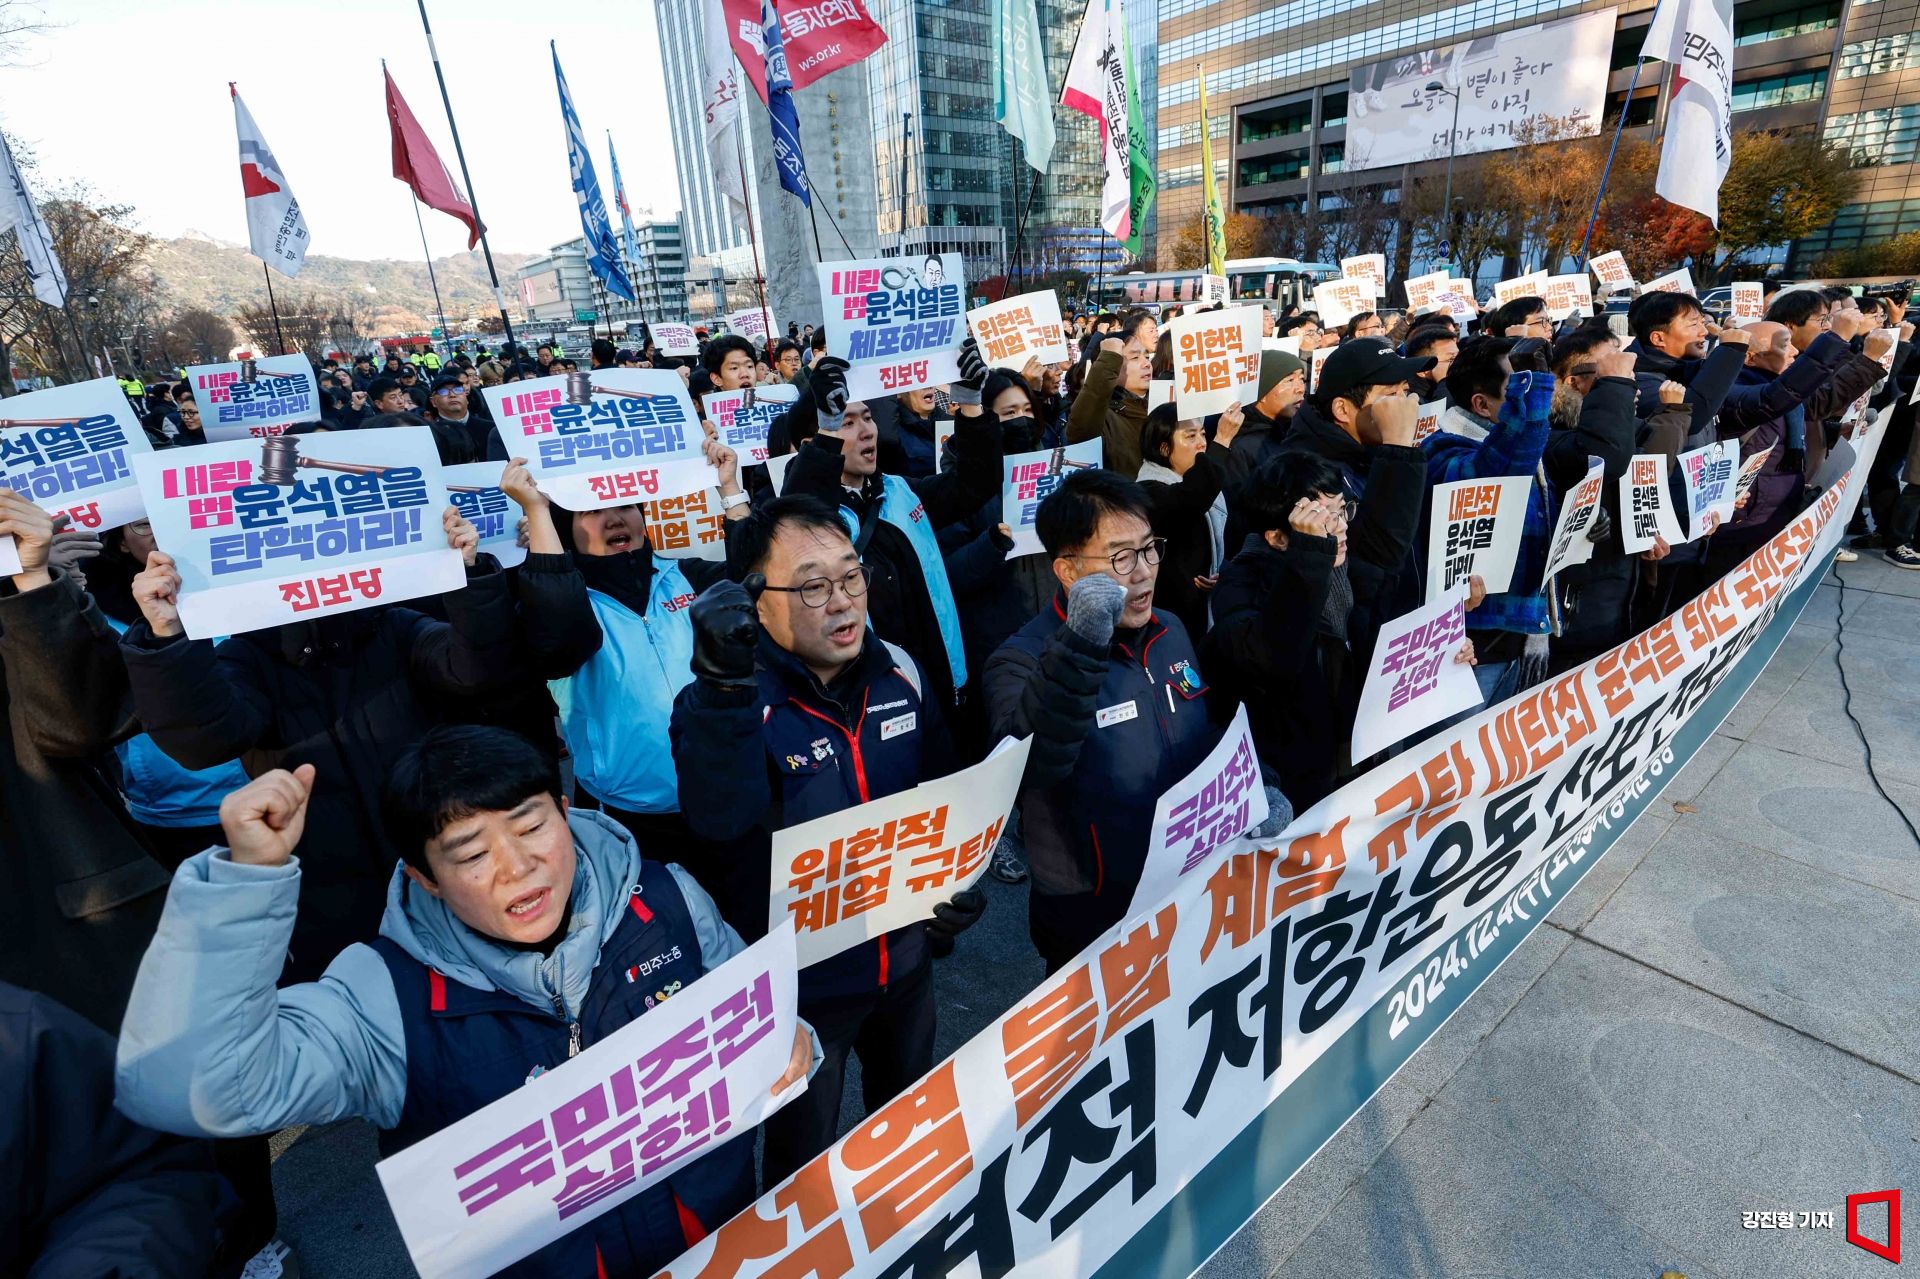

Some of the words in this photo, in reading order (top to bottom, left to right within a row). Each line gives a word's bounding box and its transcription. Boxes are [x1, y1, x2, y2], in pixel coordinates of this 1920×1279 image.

[798, 42, 842, 72] ws.or.kr
[1512, 56, 1553, 86] 좋다
[1491, 88, 1530, 115] 아직
[1481, 118, 1514, 137] 여기
[832, 269, 880, 296] 내란
[1735, 289, 1760, 303] 위헌적
[733, 311, 771, 329] 국민주권
[844, 293, 867, 320] 범
[866, 284, 960, 326] 윤석열을
[1735, 303, 1752, 318] 계엄
[655, 327, 694, 338] 국민주권
[977, 306, 1034, 339] 위헌적
[667, 337, 690, 348] 실현!
[848, 318, 955, 361] 체포하라!
[984, 335, 1026, 362] 계엄
[1027, 323, 1062, 349] 규탄!
[1179, 324, 1243, 363] 위헌적
[198, 371, 239, 390] 내란
[210, 388, 231, 404] 범
[229, 373, 311, 403] 윤석열을
[880, 360, 929, 390] 진보당
[1182, 358, 1231, 394] 계엄
[1234, 352, 1260, 386] 규탄!
[219, 394, 310, 423] 탄핵하라!
[501, 389, 562, 417] 내란
[520, 413, 553, 436] 범
[549, 394, 687, 436] 윤석열을
[711, 398, 741, 415] 내란
[0, 413, 129, 473] 석열을
[538, 424, 686, 469] 탄핵하라!
[163, 460, 252, 499] 내란
[1011, 461, 1047, 484] 내란
[1631, 460, 1657, 485] 내란죄
[1686, 454, 1703, 474] 내란
[189, 496, 234, 530] 범
[232, 466, 429, 530] 윤석열을
[588, 469, 660, 501] 진보당
[1017, 481, 1037, 501] 범
[1632, 485, 1661, 513] 윤석열
[450, 486, 510, 518] 열을
[1448, 484, 1502, 521] 내란죄
[210, 508, 423, 576] 탄핵하라!
[1445, 517, 1496, 557] 윤석열
[279, 568, 382, 613] 진보당
[1381, 597, 1465, 677] 국민주권
[1387, 650, 1447, 714] 실현!
[1164, 732, 1257, 849] 국민주권
[788, 805, 950, 894] 위헌적
[787, 866, 893, 934] 계엄
[905, 814, 1005, 894] 규탄!
[650, 1058, 975, 1279] 석열
[1001, 904, 1178, 1131] 불법
[1200, 815, 1351, 965] 계엄
[1366, 740, 1475, 876] 규탄
[1477, 667, 1599, 797] 내란죄
[1594, 615, 1687, 719] 윤석열
[1681, 577, 1739, 653] 퇴진
[1733, 516, 1815, 611] 국민주권
[1182, 770, 1552, 1119] 저항운동
[1542, 690, 1670, 852] 선포
[639, 945, 682, 976] 민주노총
[453, 970, 776, 1218] 국민주권
[552, 1077, 732, 1222] 실현!
